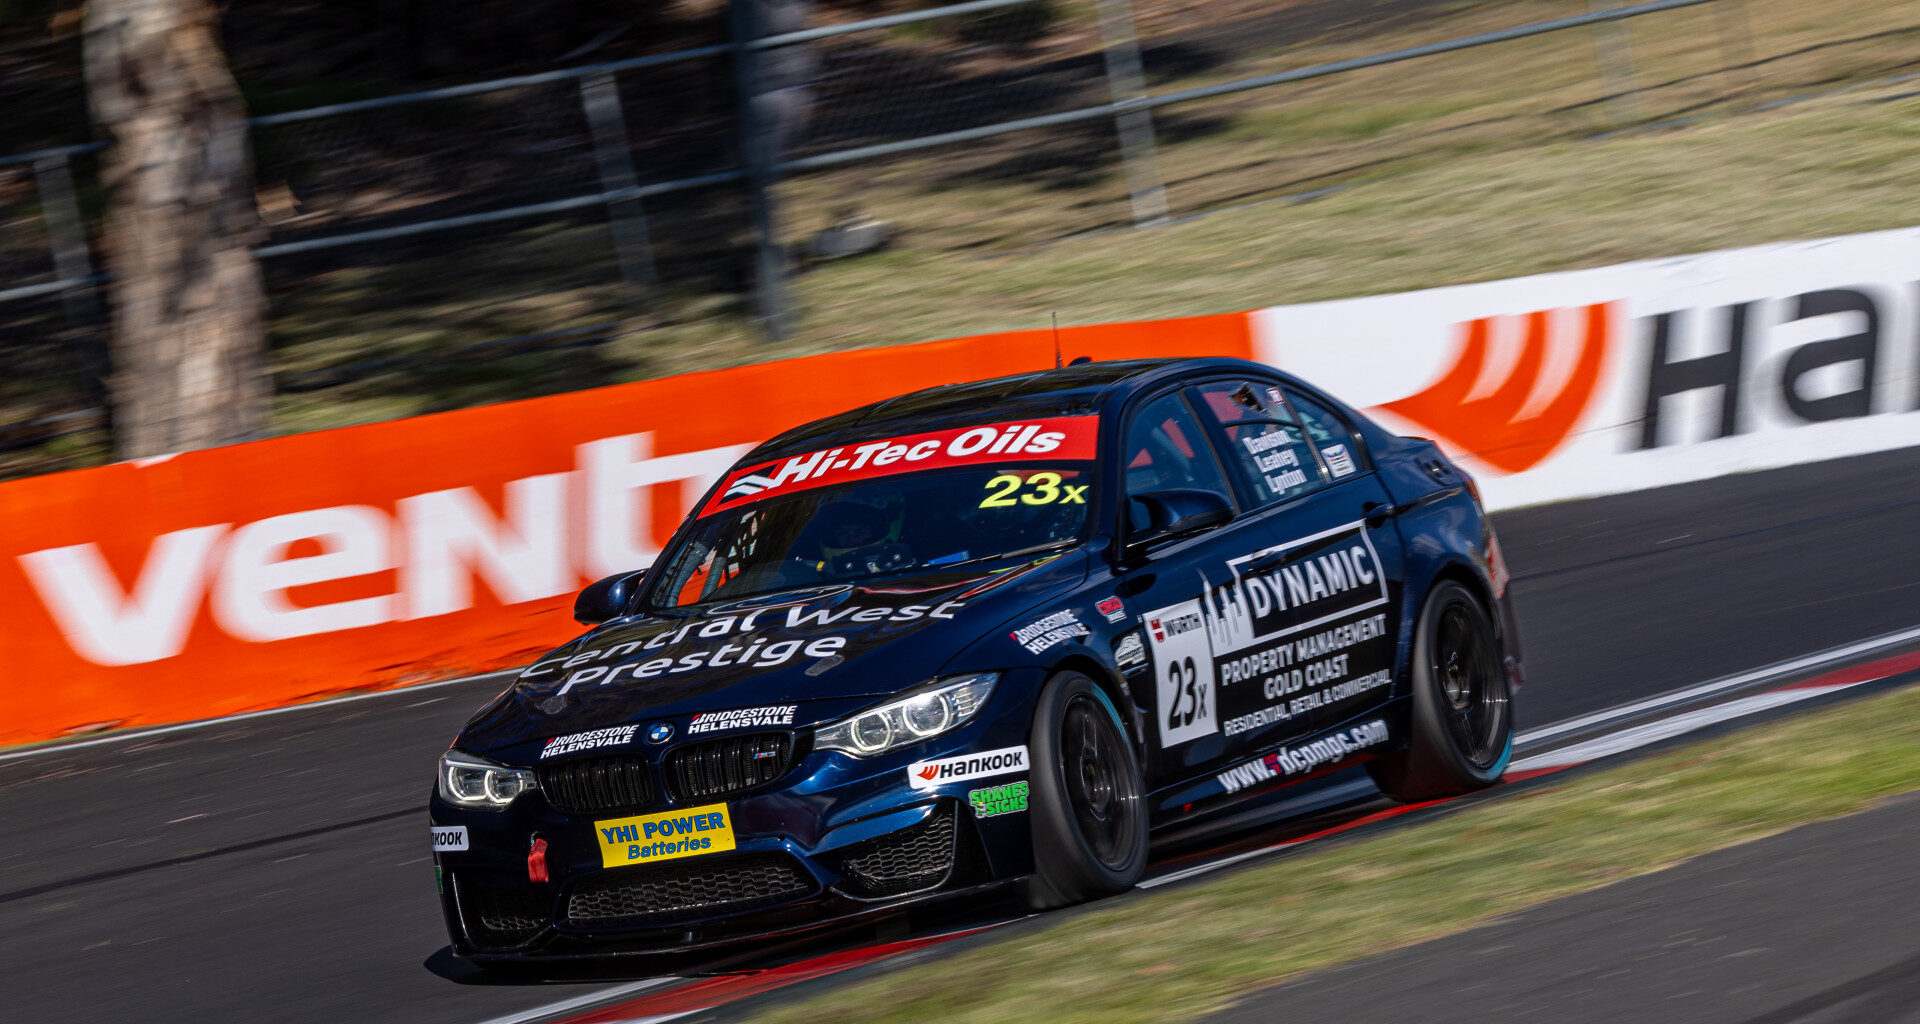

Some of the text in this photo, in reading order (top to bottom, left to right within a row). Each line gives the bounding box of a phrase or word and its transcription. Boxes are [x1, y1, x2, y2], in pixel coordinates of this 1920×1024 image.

[768, 425, 1066, 489] Hi-Tec Oils
[1245, 546, 1375, 619] DYNAMIC
[519, 600, 967, 680] Central West
[1221, 613, 1386, 686] PROPERTY MANAGEMENT
[556, 636, 848, 696] Prestige
[1264, 653, 1349, 699] GOLD COAST
[1290, 692, 1323, 714] RETAIL
[1322, 688, 1334, 704] &
[1331, 668, 1392, 700] COMMERCIAL
[688, 715, 794, 735] HELENSVALE
[690, 705, 798, 726] BRIDGESTONE
[540, 734, 634, 759] HELENSVALE
[545, 724, 640, 749] BRIDGESTONE
[971, 782, 1028, 803] SHANES
[985, 797, 1028, 816] SIGNS
[601, 812, 726, 844] YHI POWER
[628, 836, 711, 860] Batteries
